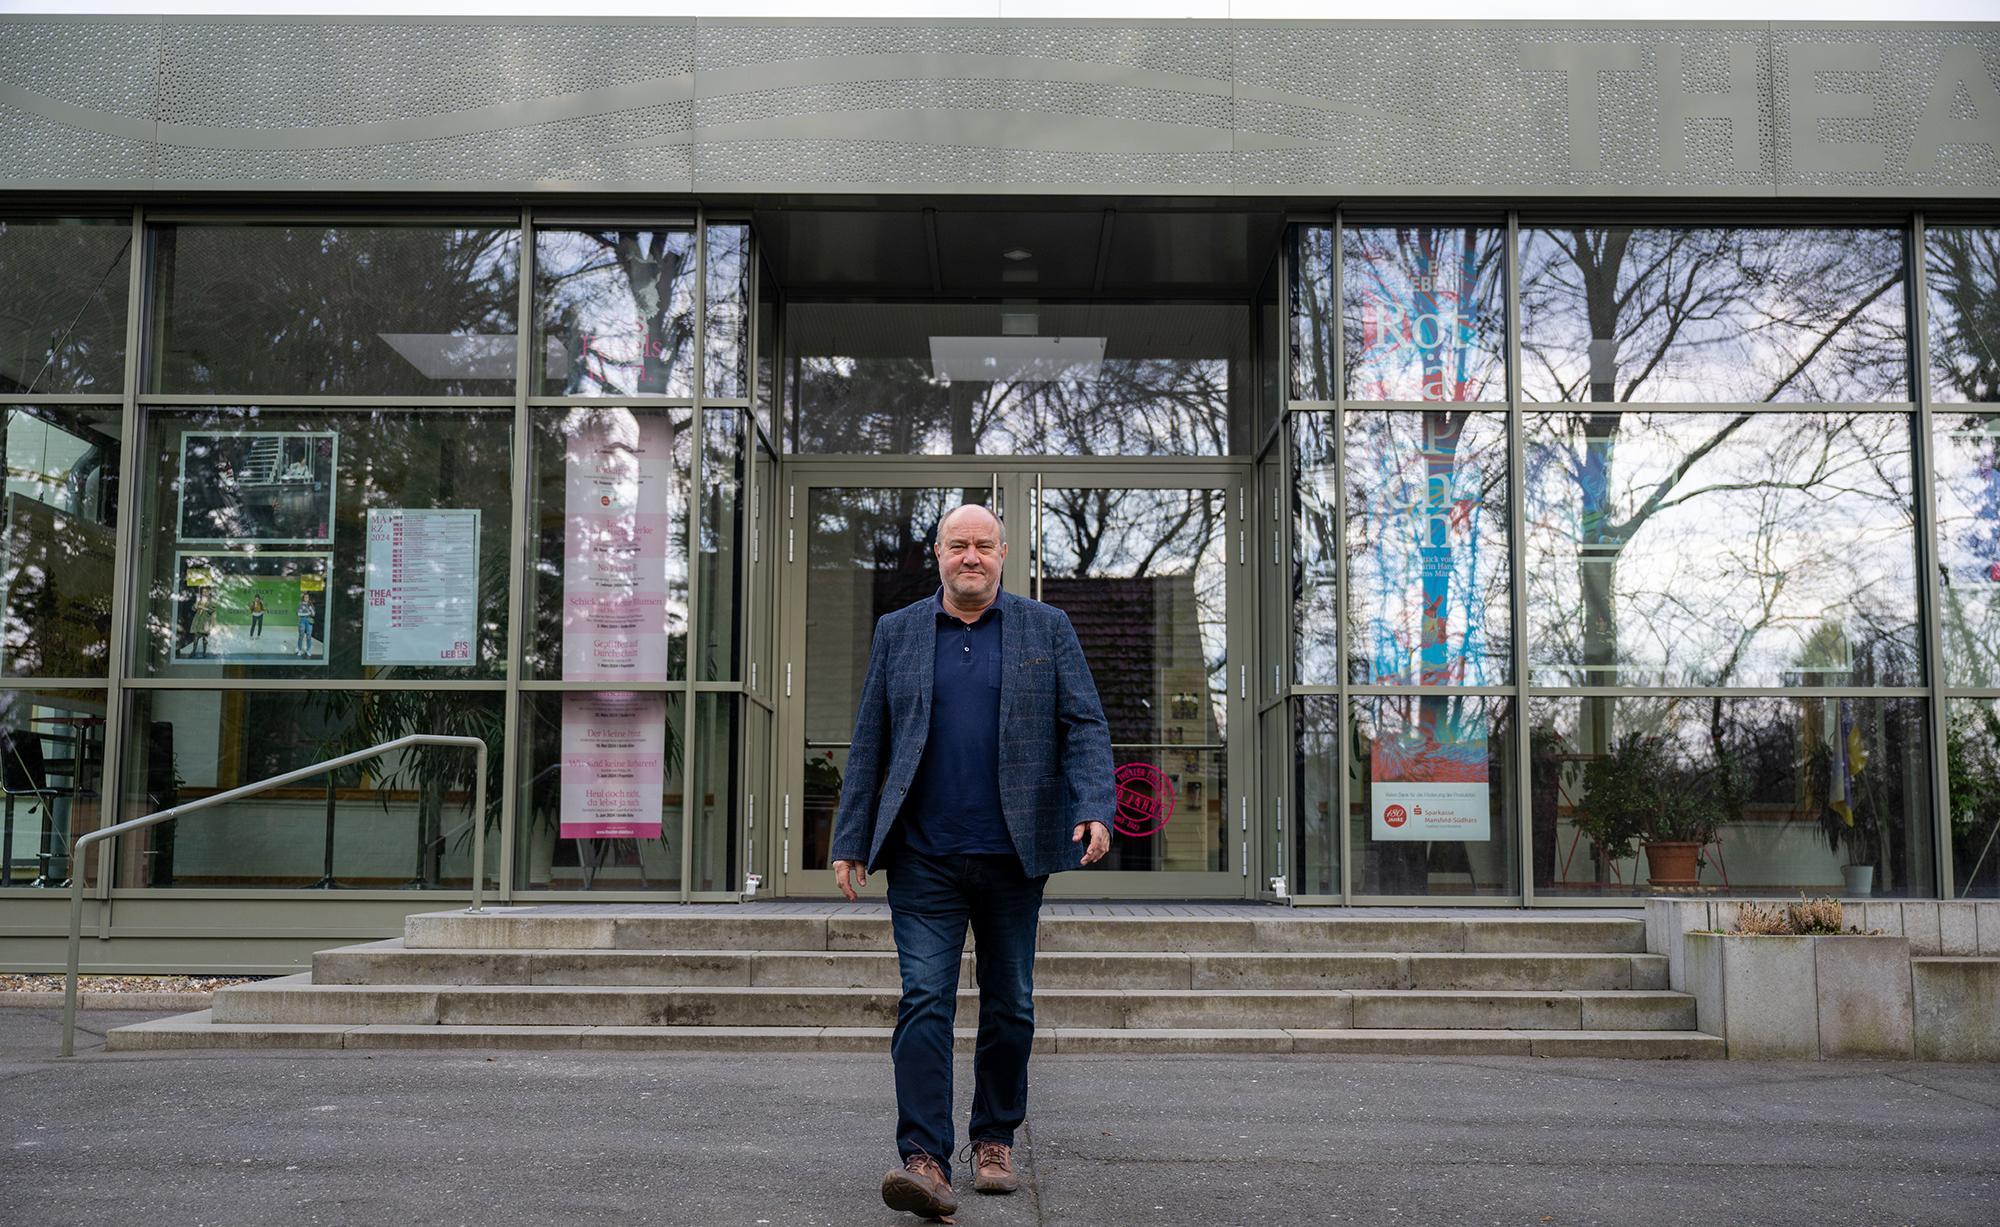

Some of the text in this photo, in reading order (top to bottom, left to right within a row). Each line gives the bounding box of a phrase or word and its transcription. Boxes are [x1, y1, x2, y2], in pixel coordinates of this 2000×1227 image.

[369, 589, 392, 598] THEA
[369, 598, 386, 606] TER
[454, 641, 468, 650] EIS
[440, 650, 468, 659] LEBEN
[587, 729, 601, 737] Der
[1424, 809, 1455, 817] Sparkasse
